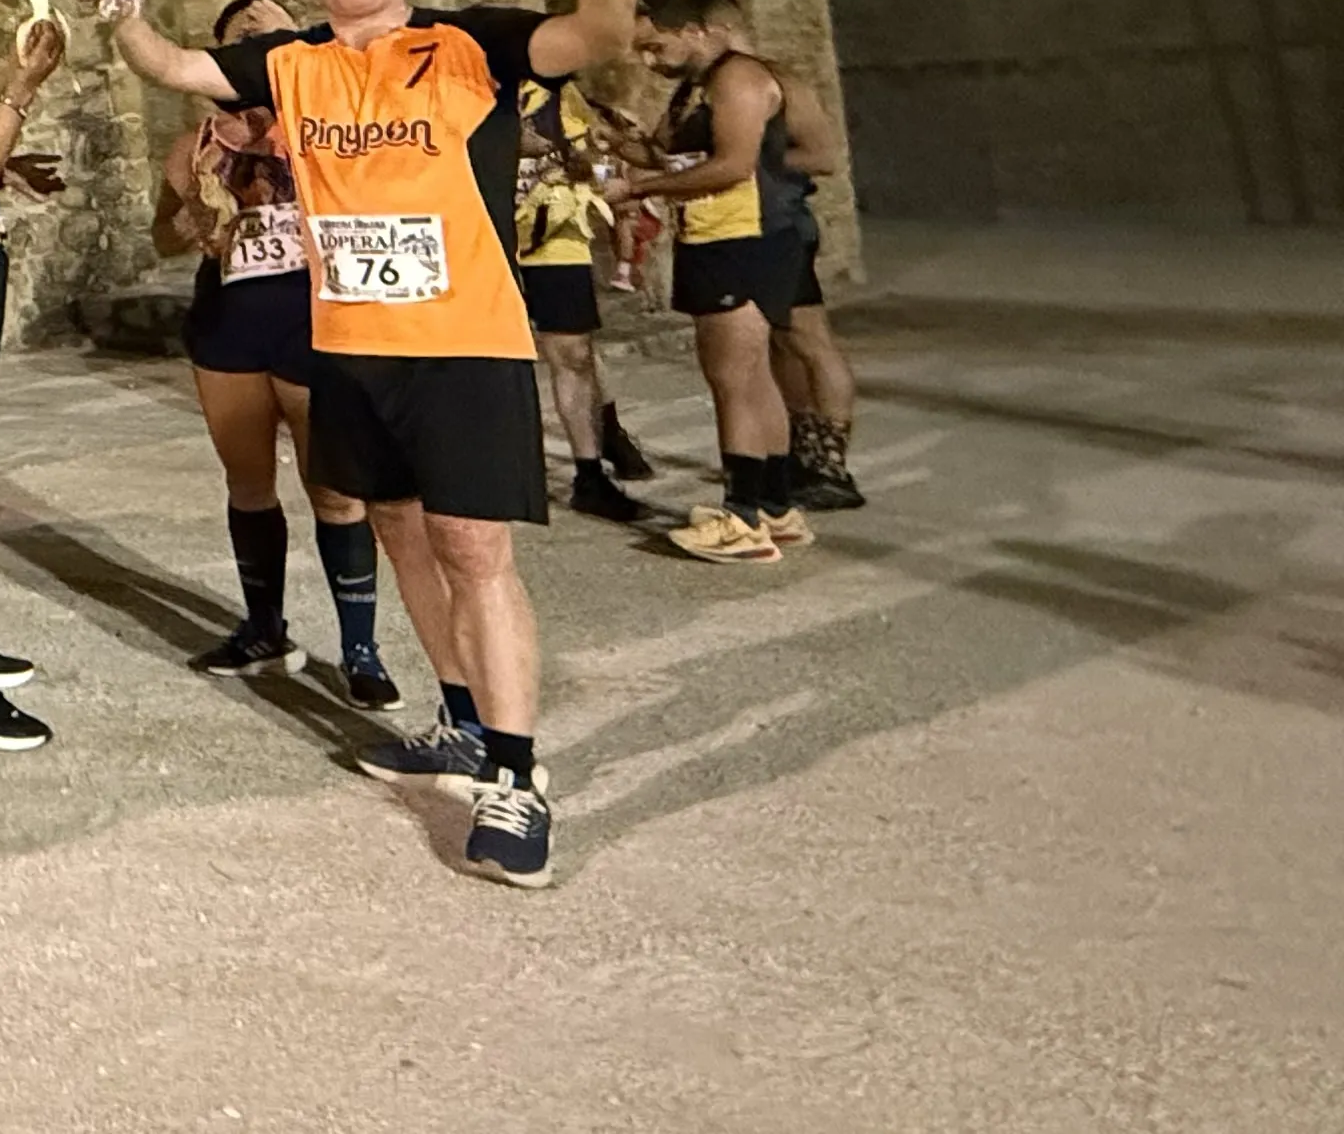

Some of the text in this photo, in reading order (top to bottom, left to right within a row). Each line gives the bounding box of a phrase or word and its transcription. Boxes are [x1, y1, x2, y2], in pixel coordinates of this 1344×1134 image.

[404, 41, 440, 89] 7
[239, 237, 286, 264] 133
[319, 233, 389, 251] LOPERA
[356, 257, 400, 286] 76
